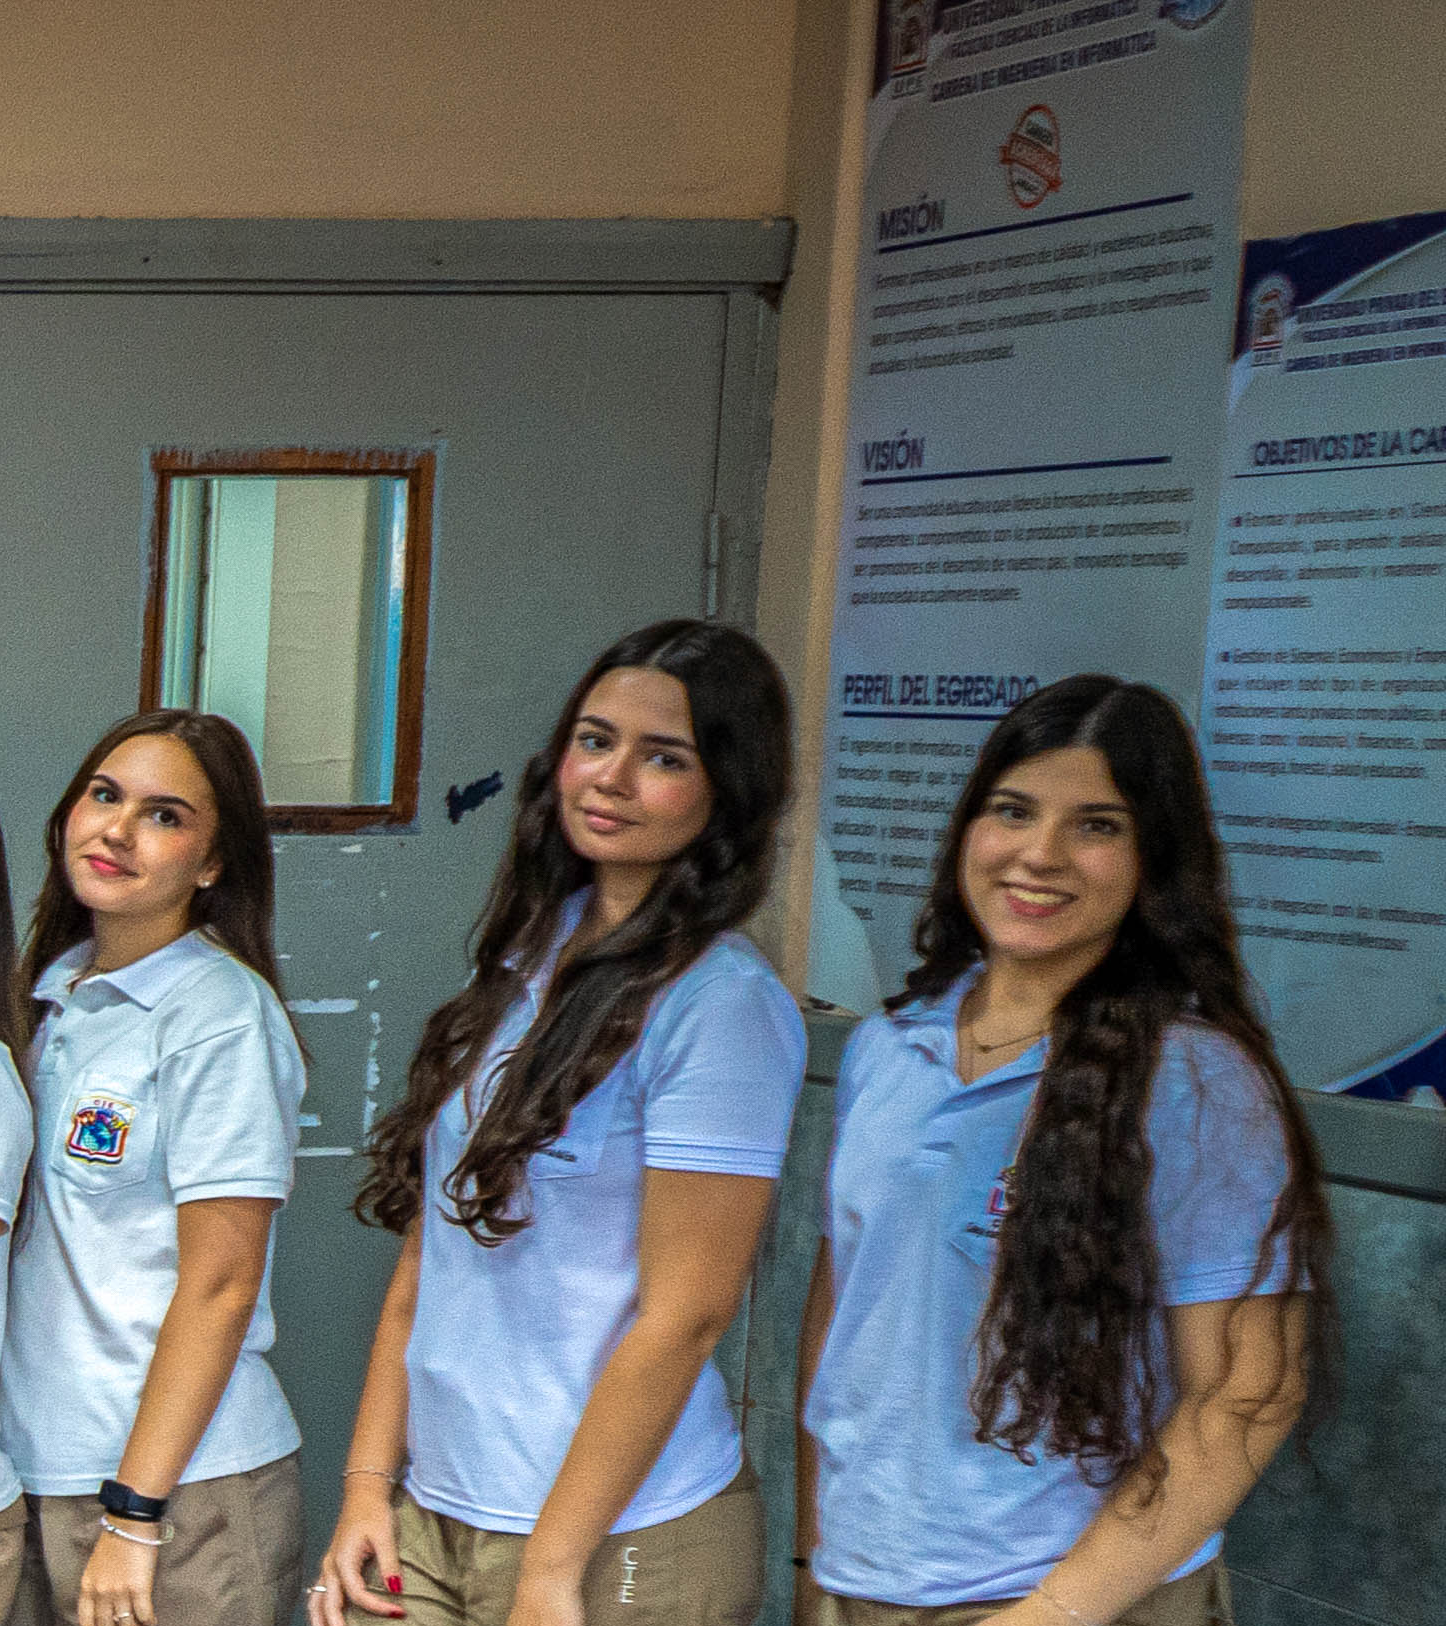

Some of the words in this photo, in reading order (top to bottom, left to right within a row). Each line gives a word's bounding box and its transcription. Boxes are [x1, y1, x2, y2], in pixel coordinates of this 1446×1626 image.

[878, 194, 945, 240] MISIÓN
[863, 431, 925, 473] VISIÓN
[1254, 435, 1352, 467] OBJETIVOS
[1352, 431, 1377, 460] DE
[1381, 429, 1403, 458] LA
[844, 673, 894, 705] PERFIL
[899, 674, 930, 706] DEL
